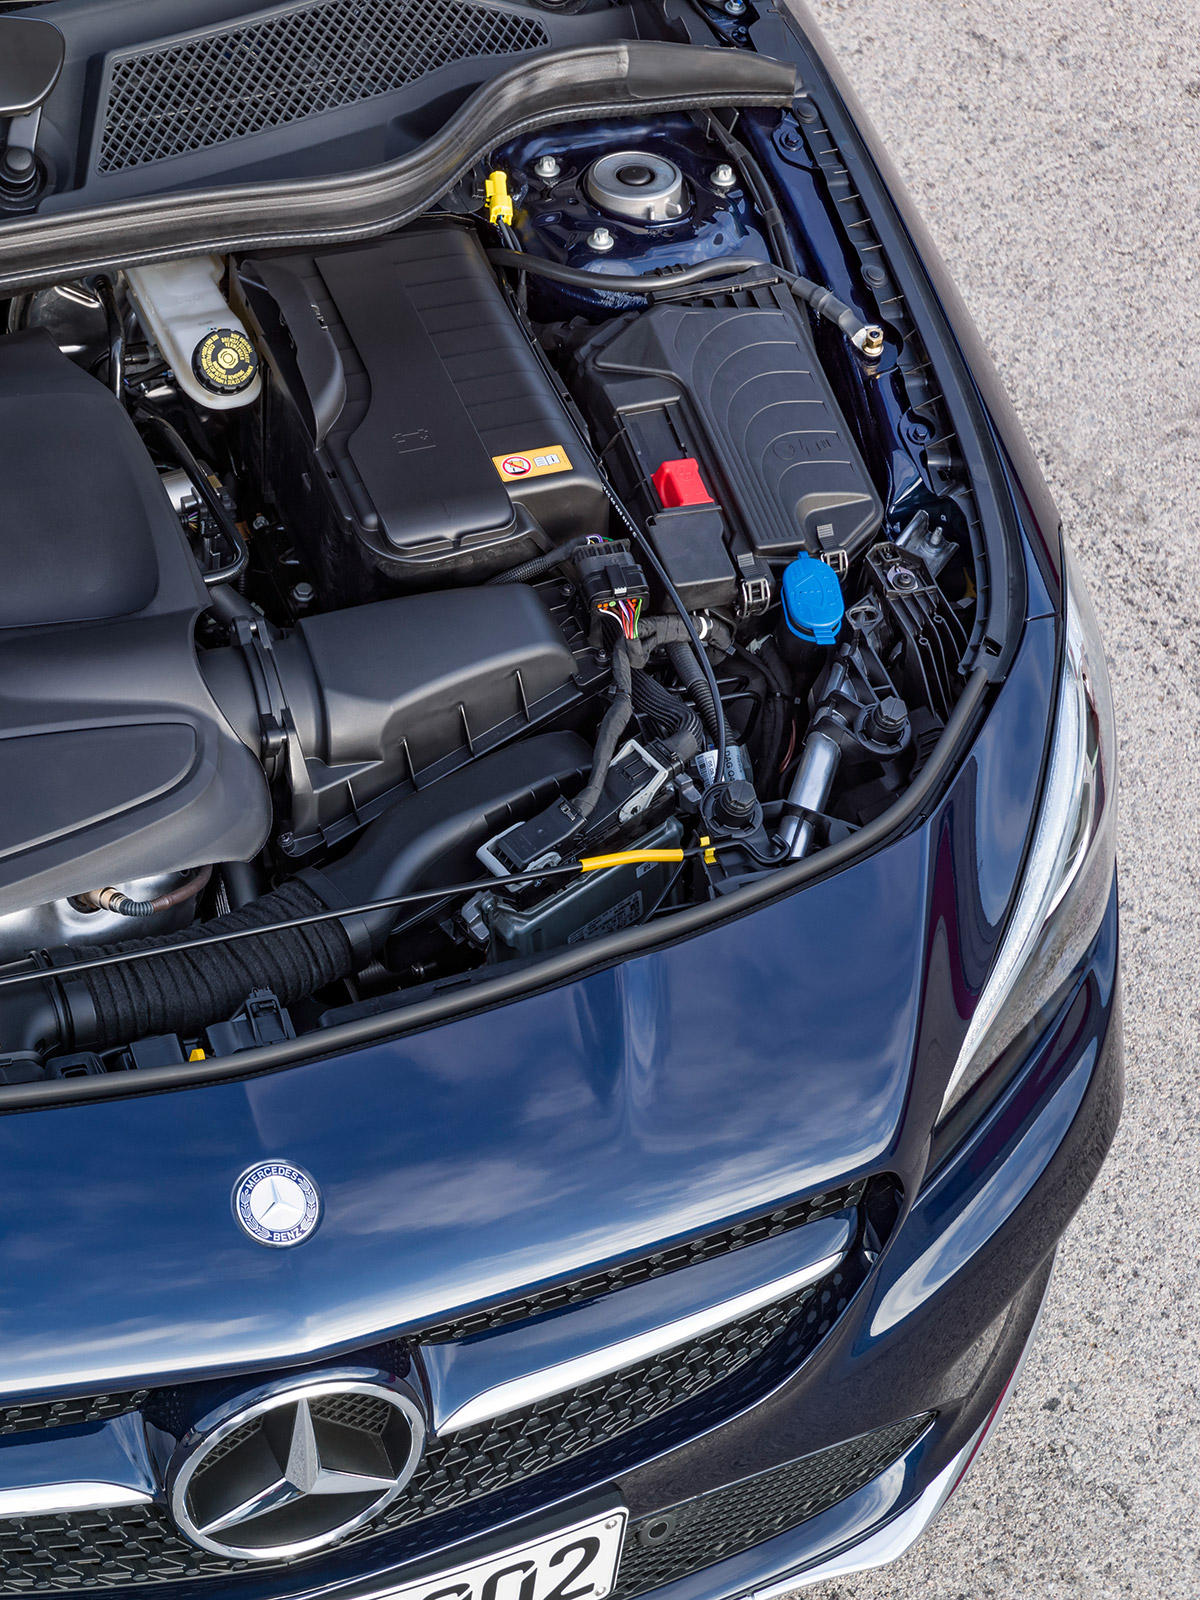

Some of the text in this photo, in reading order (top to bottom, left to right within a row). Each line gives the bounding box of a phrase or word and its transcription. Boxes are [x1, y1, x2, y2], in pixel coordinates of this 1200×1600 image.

[245, 1167, 298, 1190] MERCEDES
[273, 1229, 302, 1241] BENZ
[423, 1536, 601, 1600] 02
